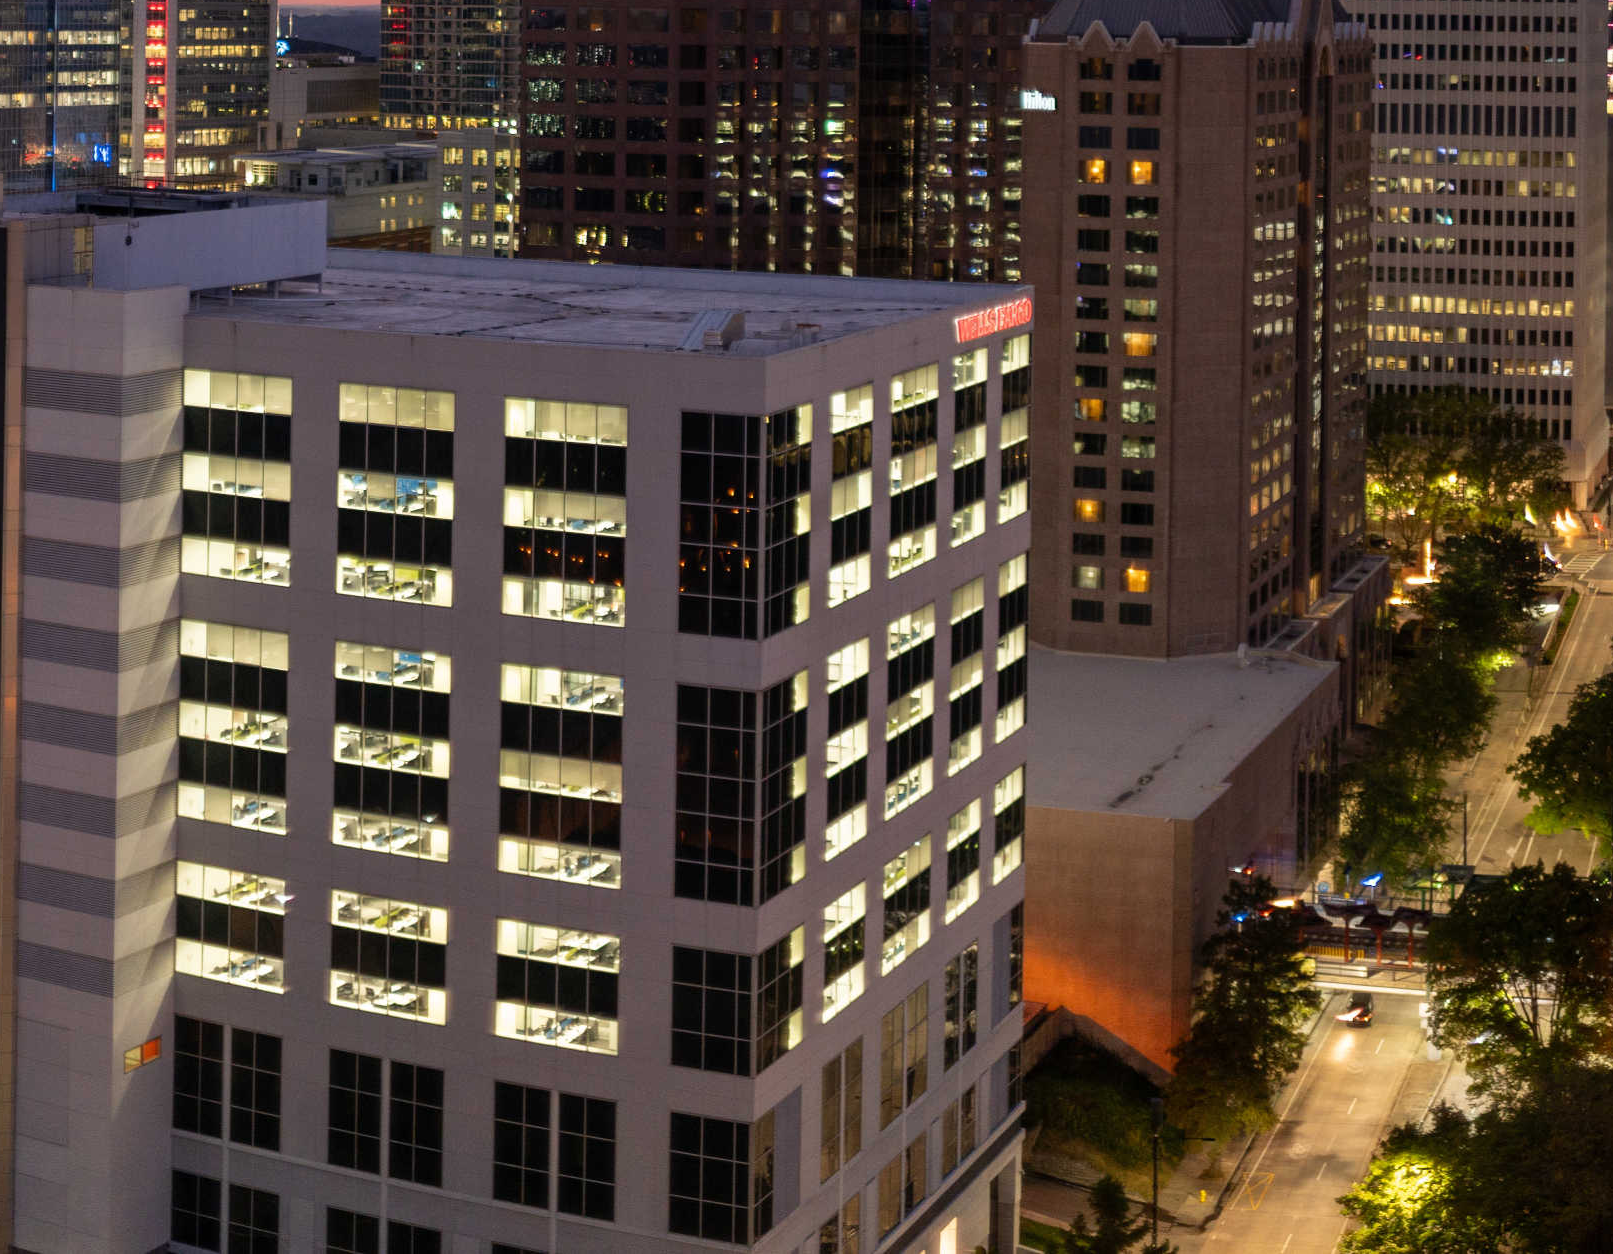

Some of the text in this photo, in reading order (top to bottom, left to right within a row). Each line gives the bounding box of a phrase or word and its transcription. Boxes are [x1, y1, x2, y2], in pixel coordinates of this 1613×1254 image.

[1021, 89, 1056, 111] Hilton
[954, 297, 1033, 344] WELLS FARGO
